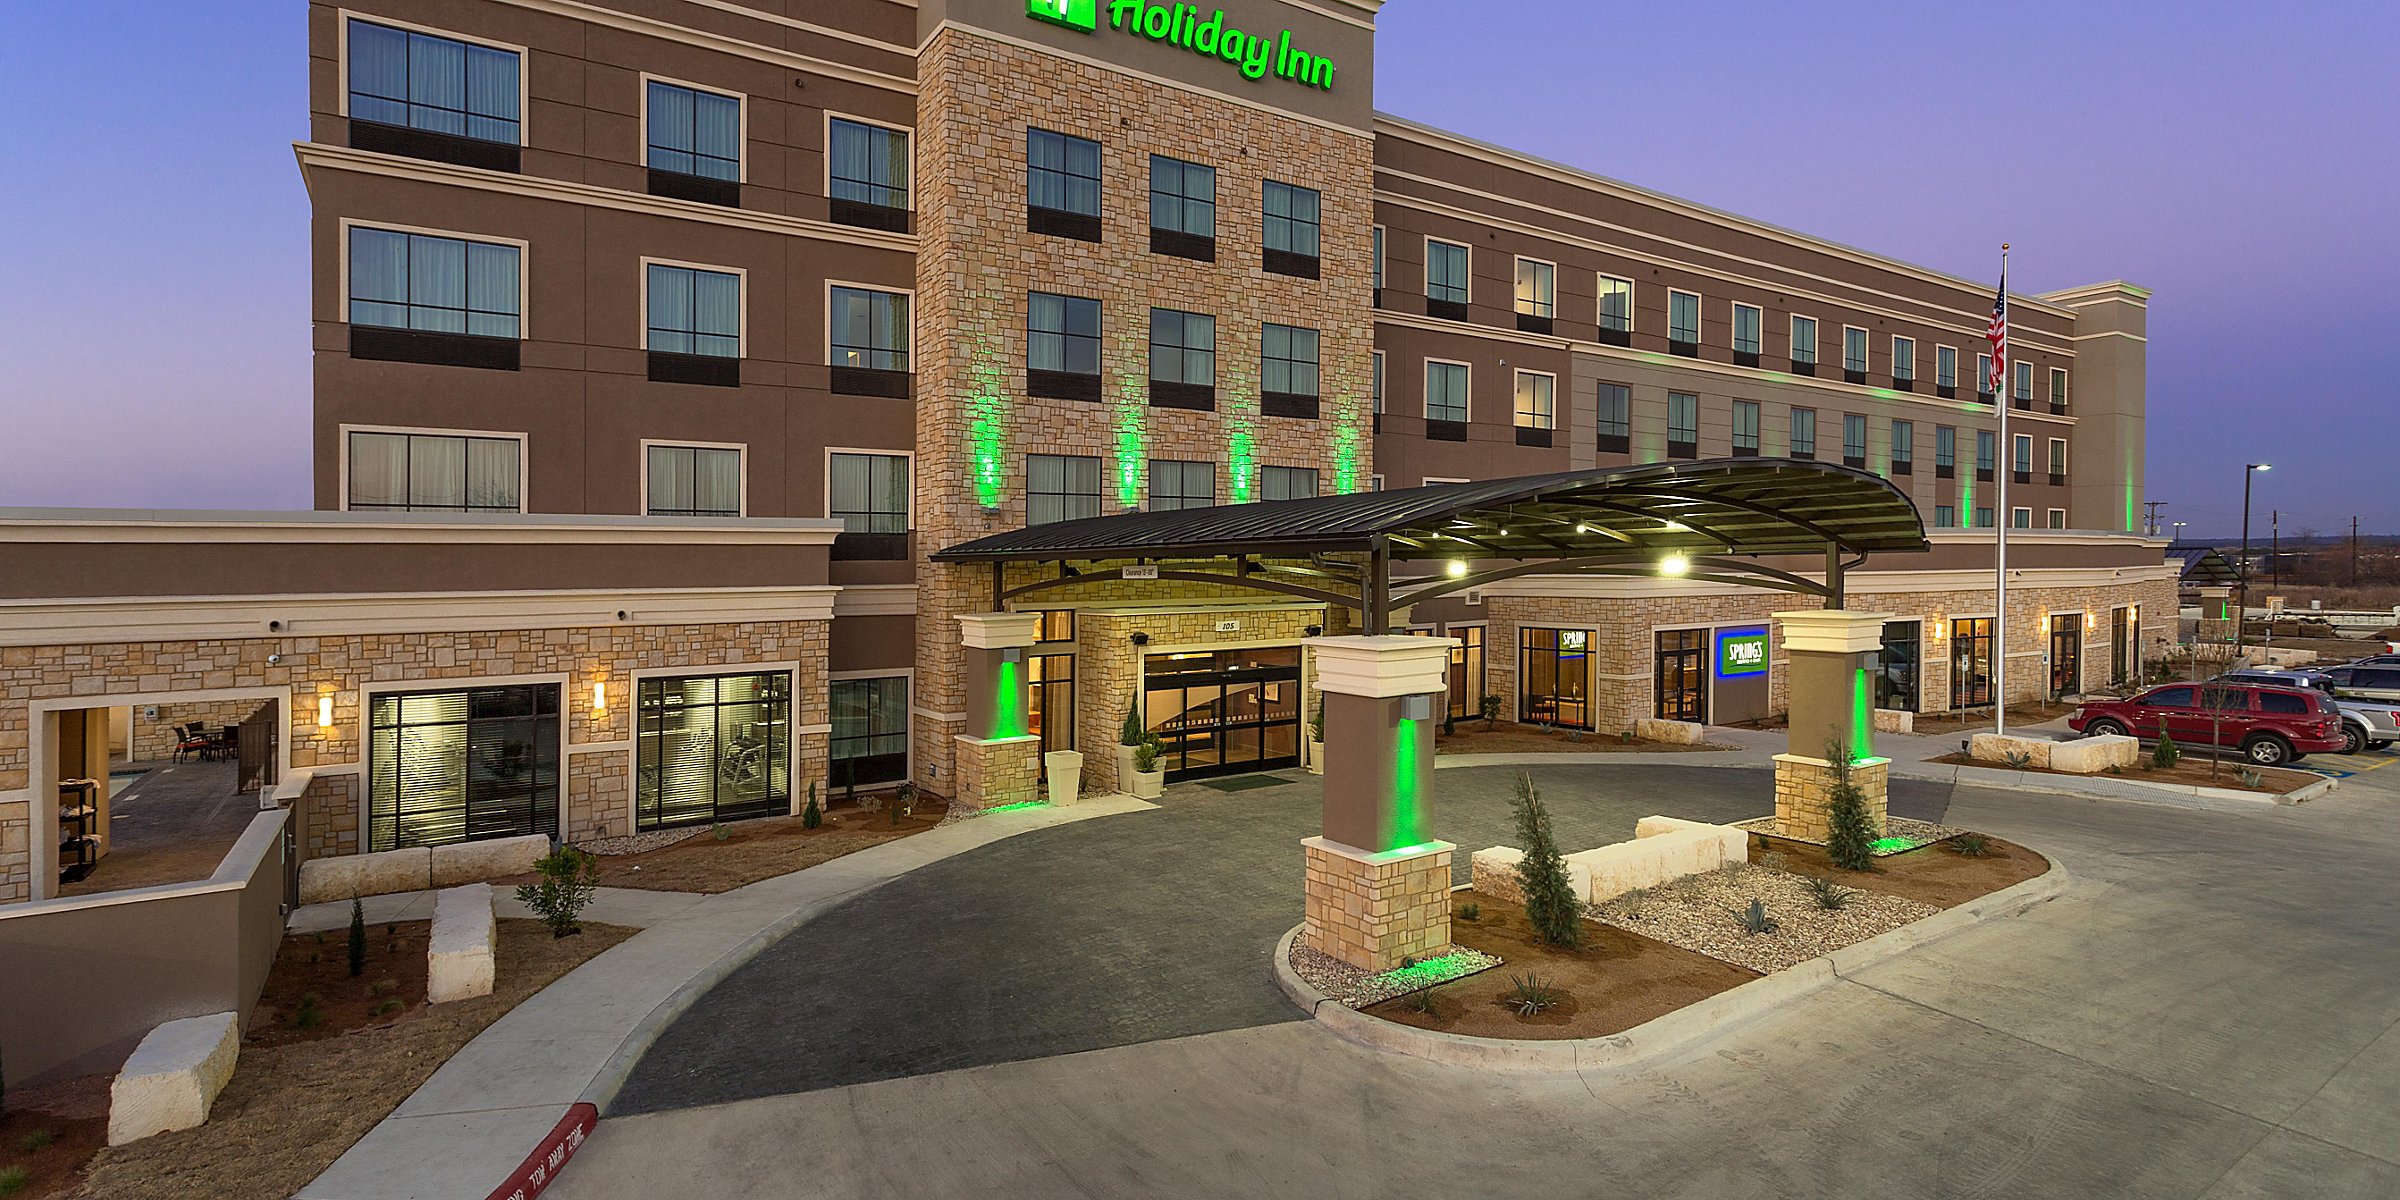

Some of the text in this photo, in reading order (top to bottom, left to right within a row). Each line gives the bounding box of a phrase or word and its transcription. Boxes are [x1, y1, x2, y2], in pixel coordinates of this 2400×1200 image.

[1107, 0, 1334, 90] Holiday Inn
[528, 1164, 545, 1189] TOW
[548, 1142, 565, 1171] AWAY
[566, 1123, 585, 1151] ZONE
